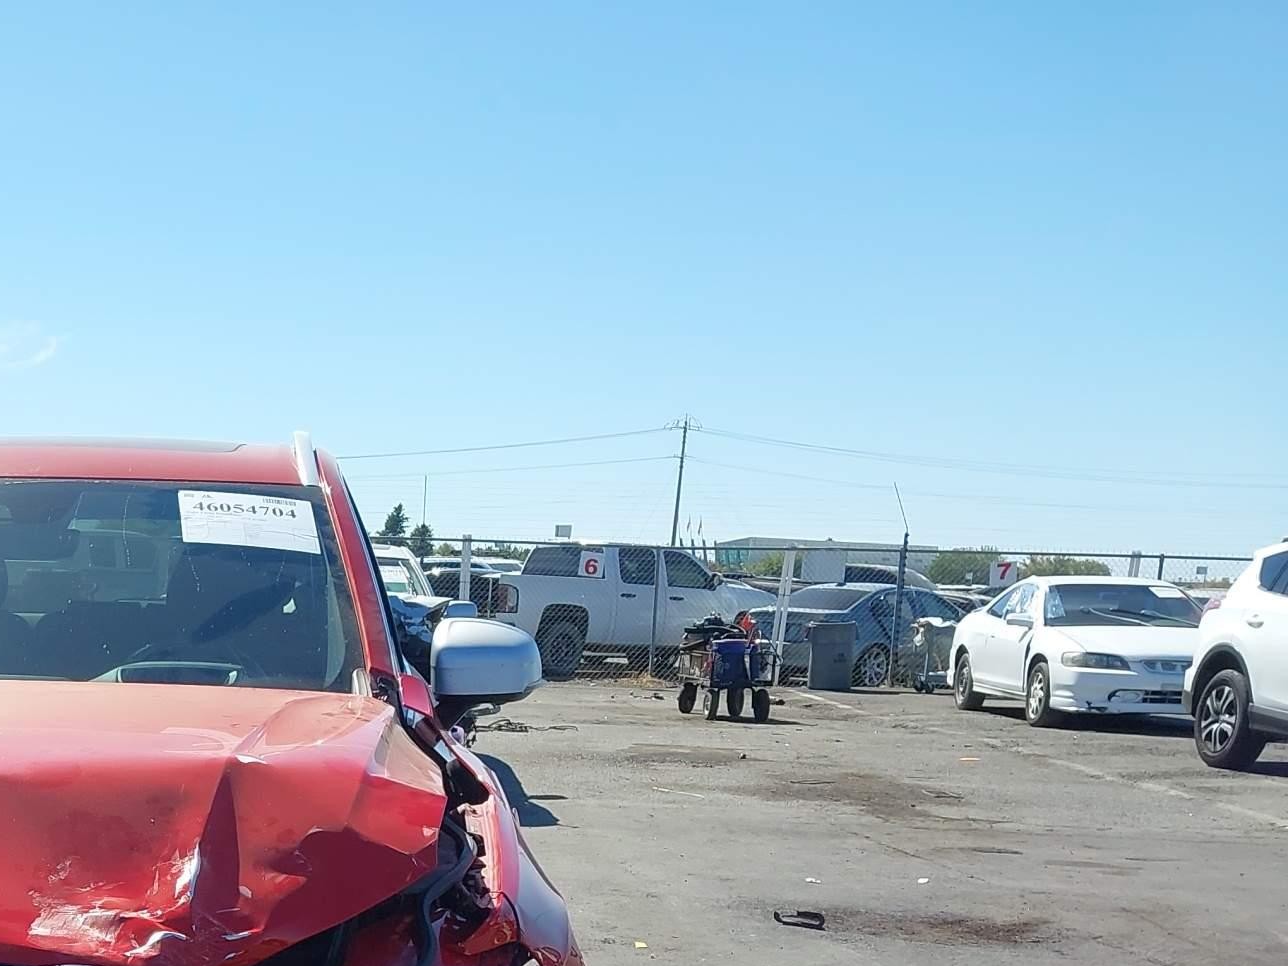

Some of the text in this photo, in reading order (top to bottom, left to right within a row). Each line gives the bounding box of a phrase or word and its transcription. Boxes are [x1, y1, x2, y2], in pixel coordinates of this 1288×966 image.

[192, 501, 297, 519] 46054704
[585, 559, 598, 575] 6
[997, 563, 1011, 580] 7
